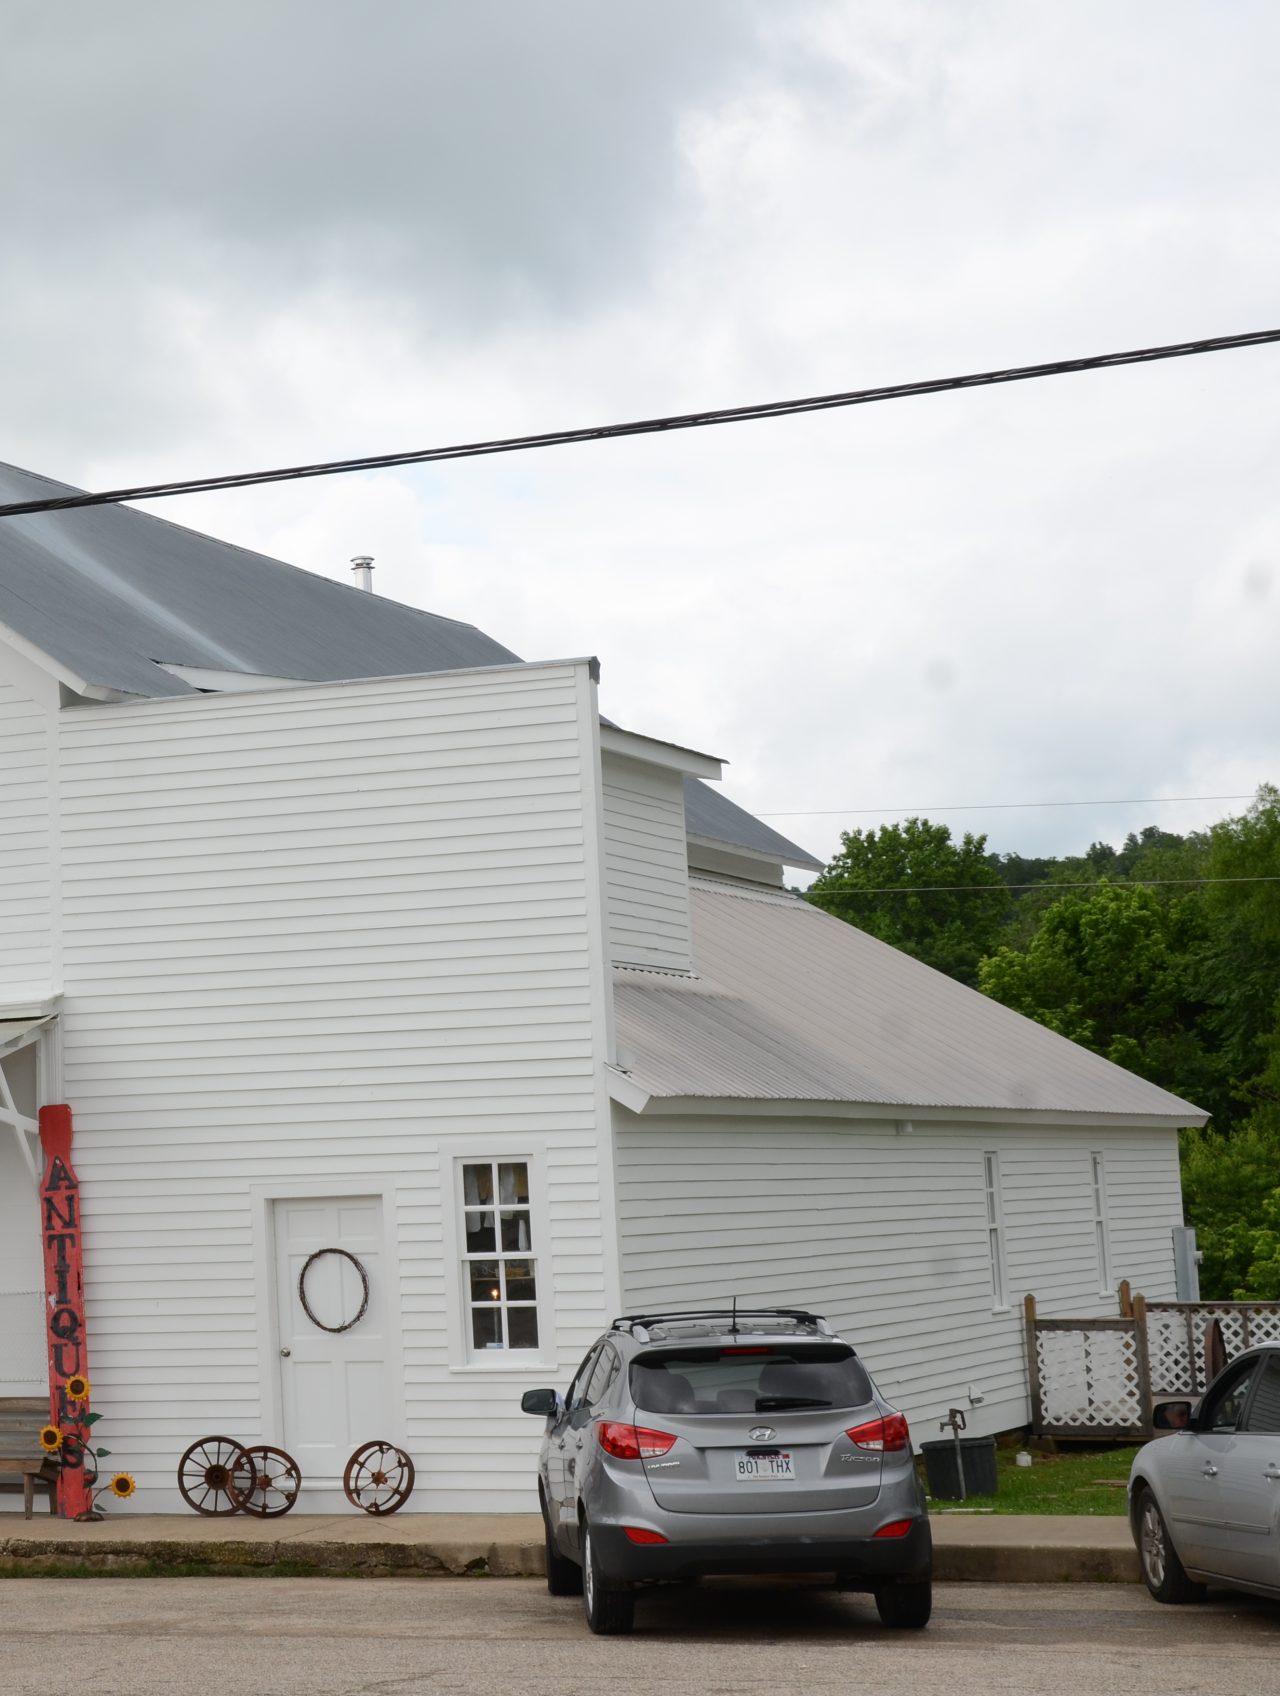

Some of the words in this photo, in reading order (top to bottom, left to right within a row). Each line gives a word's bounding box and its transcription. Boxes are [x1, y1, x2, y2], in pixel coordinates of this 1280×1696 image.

[44, 1156, 85, 1469] ANTIQUES
[738, 1461, 759, 1474] 801
[769, 1460, 791, 1473] THX
